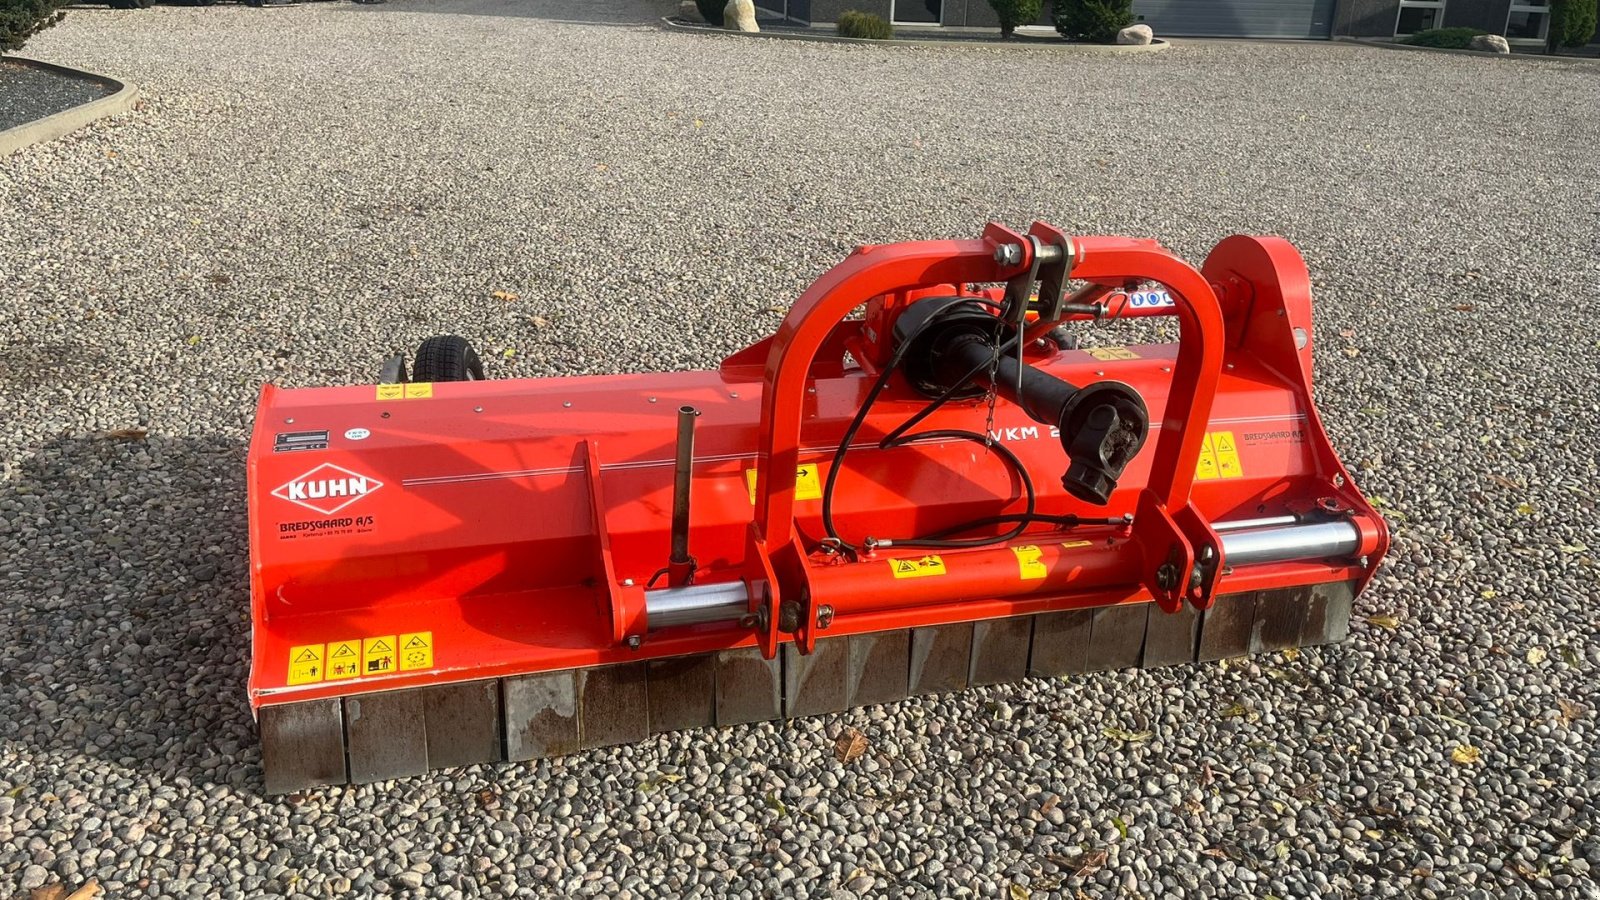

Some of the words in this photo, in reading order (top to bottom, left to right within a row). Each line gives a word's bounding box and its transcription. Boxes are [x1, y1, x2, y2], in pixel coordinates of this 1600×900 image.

[990, 426, 1039, 441] VKM
[1244, 431, 1290, 440] BREDSGAARD
[288, 477, 367, 500] KUHN
[280, 518, 353, 532] BREDSGAARD
[356, 516, 373, 527] A/S
